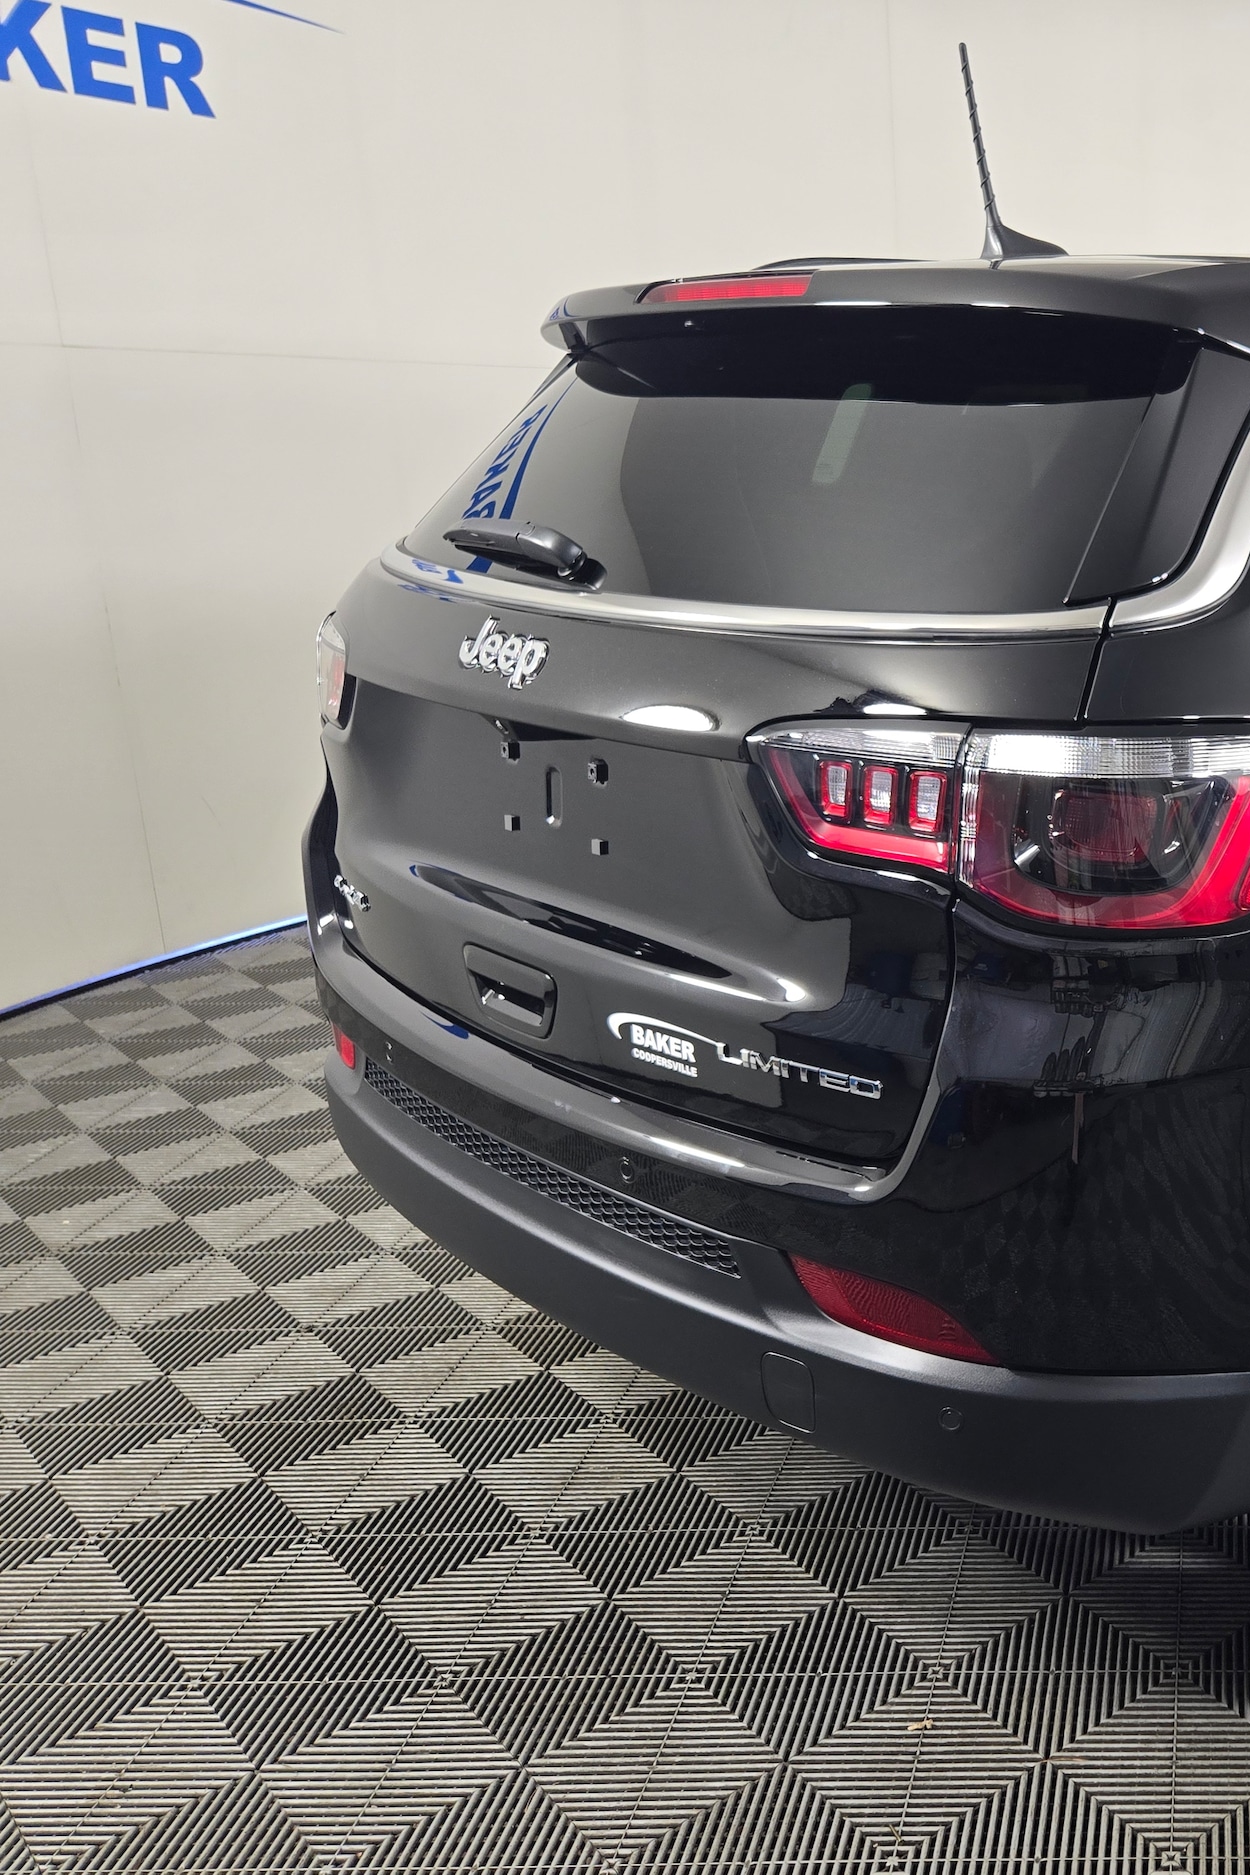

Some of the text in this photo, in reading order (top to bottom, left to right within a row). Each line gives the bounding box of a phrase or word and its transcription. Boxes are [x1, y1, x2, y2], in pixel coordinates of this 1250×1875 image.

[459, 614, 550, 690] Jeep
[630, 1023, 697, 1064] BAKER
[630, 1047, 698, 1079] COOPERSVILLE
[716, 1042, 884, 1100] LIMITED
